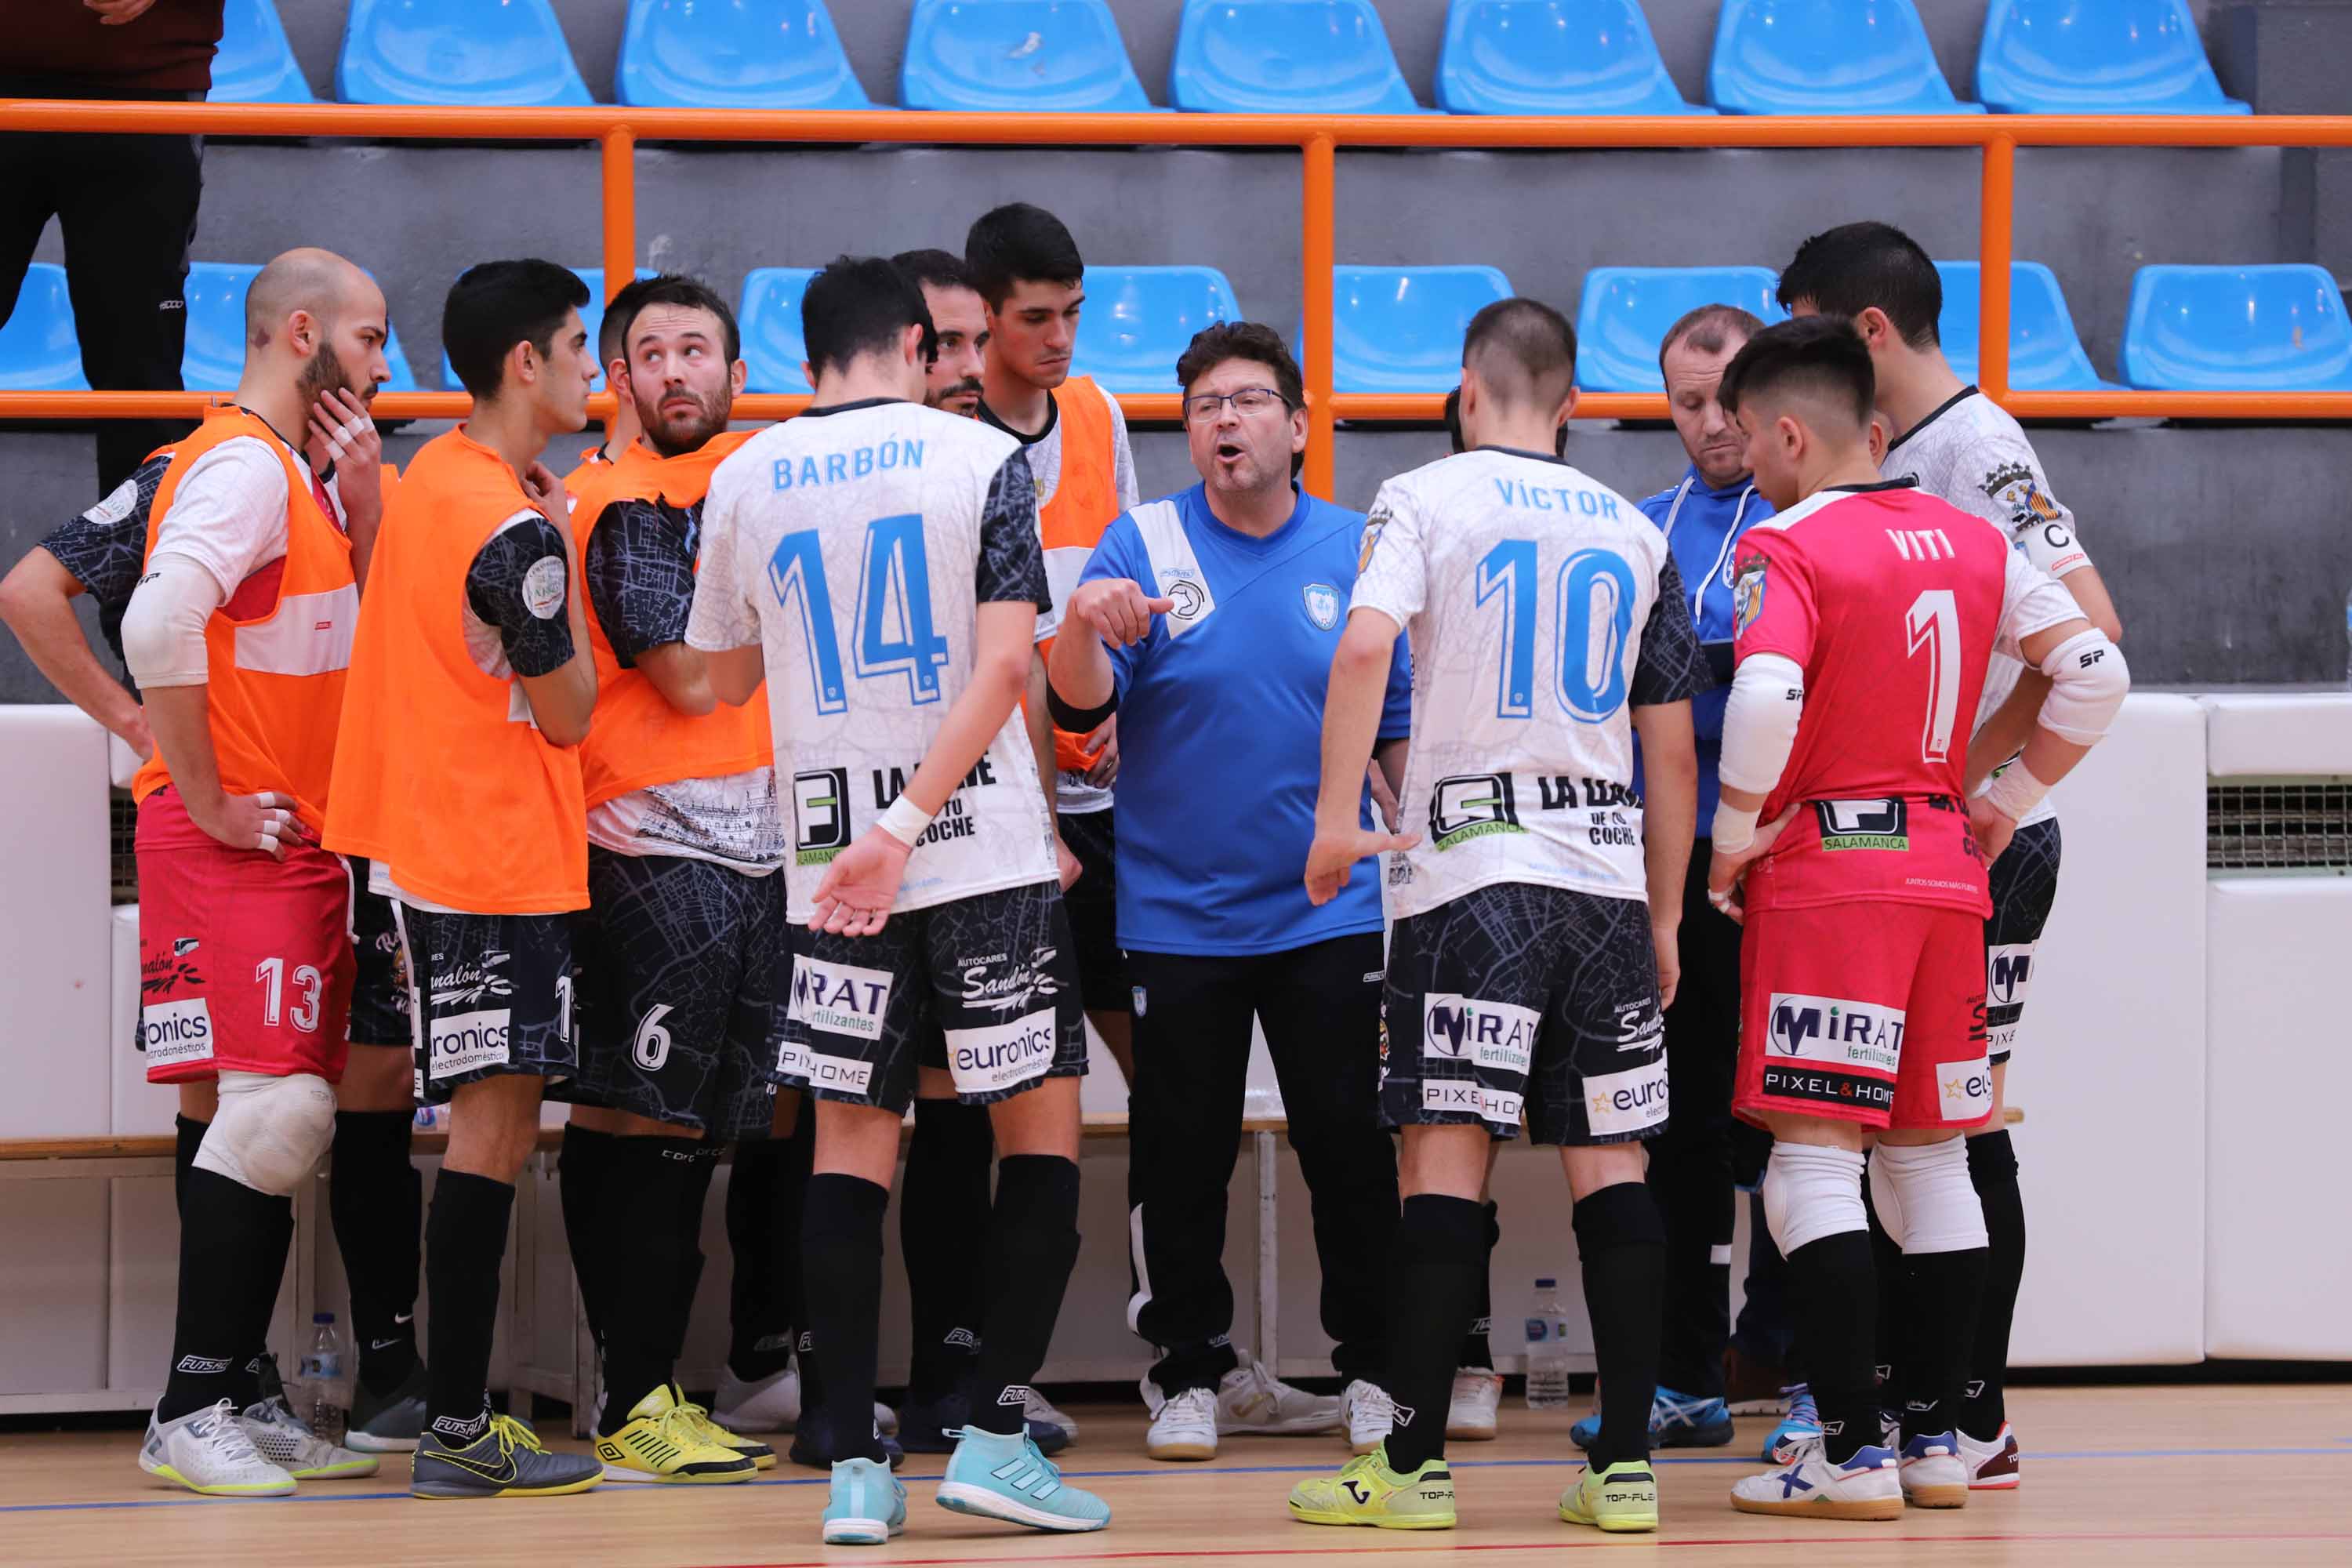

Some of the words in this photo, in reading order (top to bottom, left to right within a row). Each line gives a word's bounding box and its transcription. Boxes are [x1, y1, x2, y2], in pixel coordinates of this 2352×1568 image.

[771, 432, 924, 492] BARBÓN
[1494, 477, 1621, 522] VÍCTOR
[1886, 528, 1956, 562] VITI
[2044, 524, 2070, 548] C
[768, 513, 949, 717] 14
[1476, 538, 1636, 724] 10
[1906, 590, 1961, 764] 1
[2079, 649, 2105, 669] SP
[944, 798, 963, 817] TU
[1537, 776, 1578, 810] LA
[1824, 837, 1907, 851] SALAMANCA
[957, 953, 1008, 967] AUTOCARES
[255, 957, 323, 1033] 13
[632, 1003, 676, 1072] 6
[957, 1027, 1051, 1070] euronics
